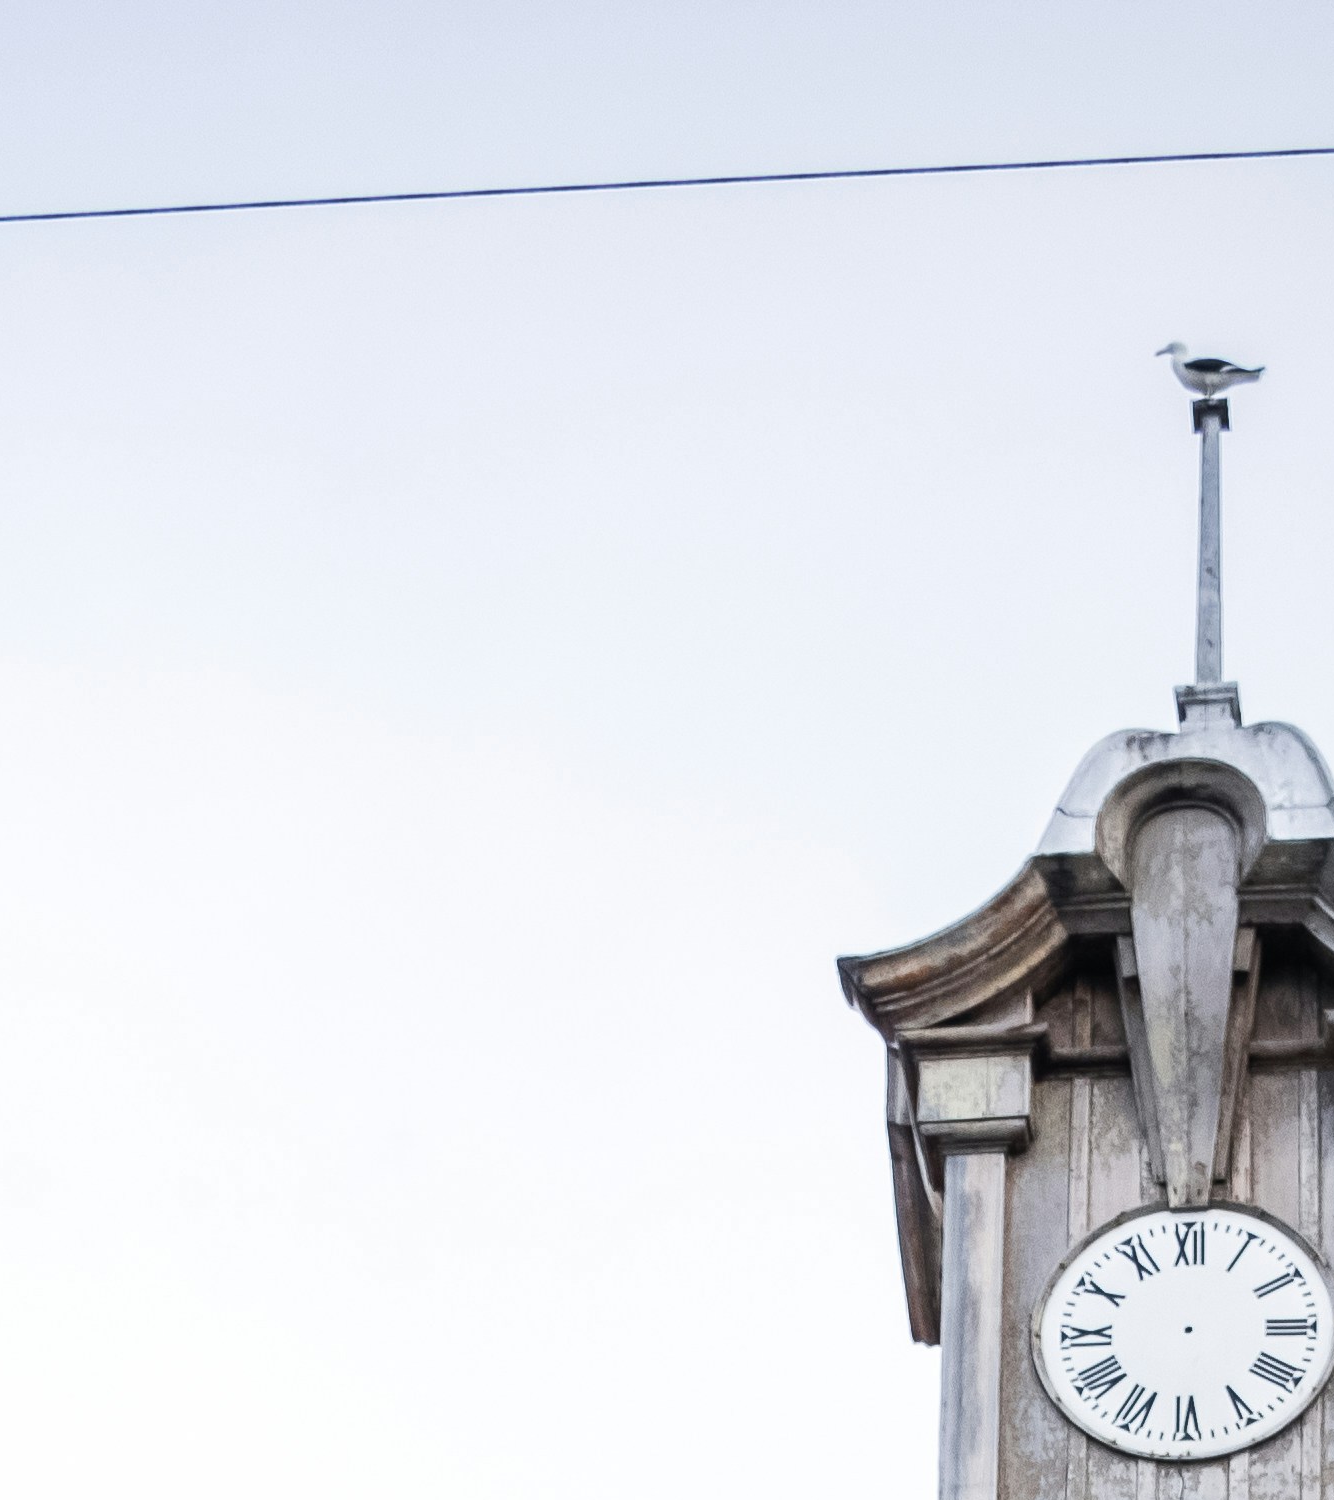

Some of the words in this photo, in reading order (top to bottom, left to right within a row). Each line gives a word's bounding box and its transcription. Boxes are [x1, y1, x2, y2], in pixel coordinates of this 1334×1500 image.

[1117, 1233, 1161, 1281] XI
[1174, 1222, 1205, 1267] XII
[1083, 1279, 1126, 1307] X
[1253, 1271, 1297, 1299] II
[1068, 1325, 1113, 1347] IX
[1265, 1319, 1309, 1336] III
[1077, 1354, 1128, 1400] VIII
[1115, 1383, 1158, 1430] VII
[1174, 1395, 1202, 1435] VI
[1226, 1384, 1254, 1420] V
